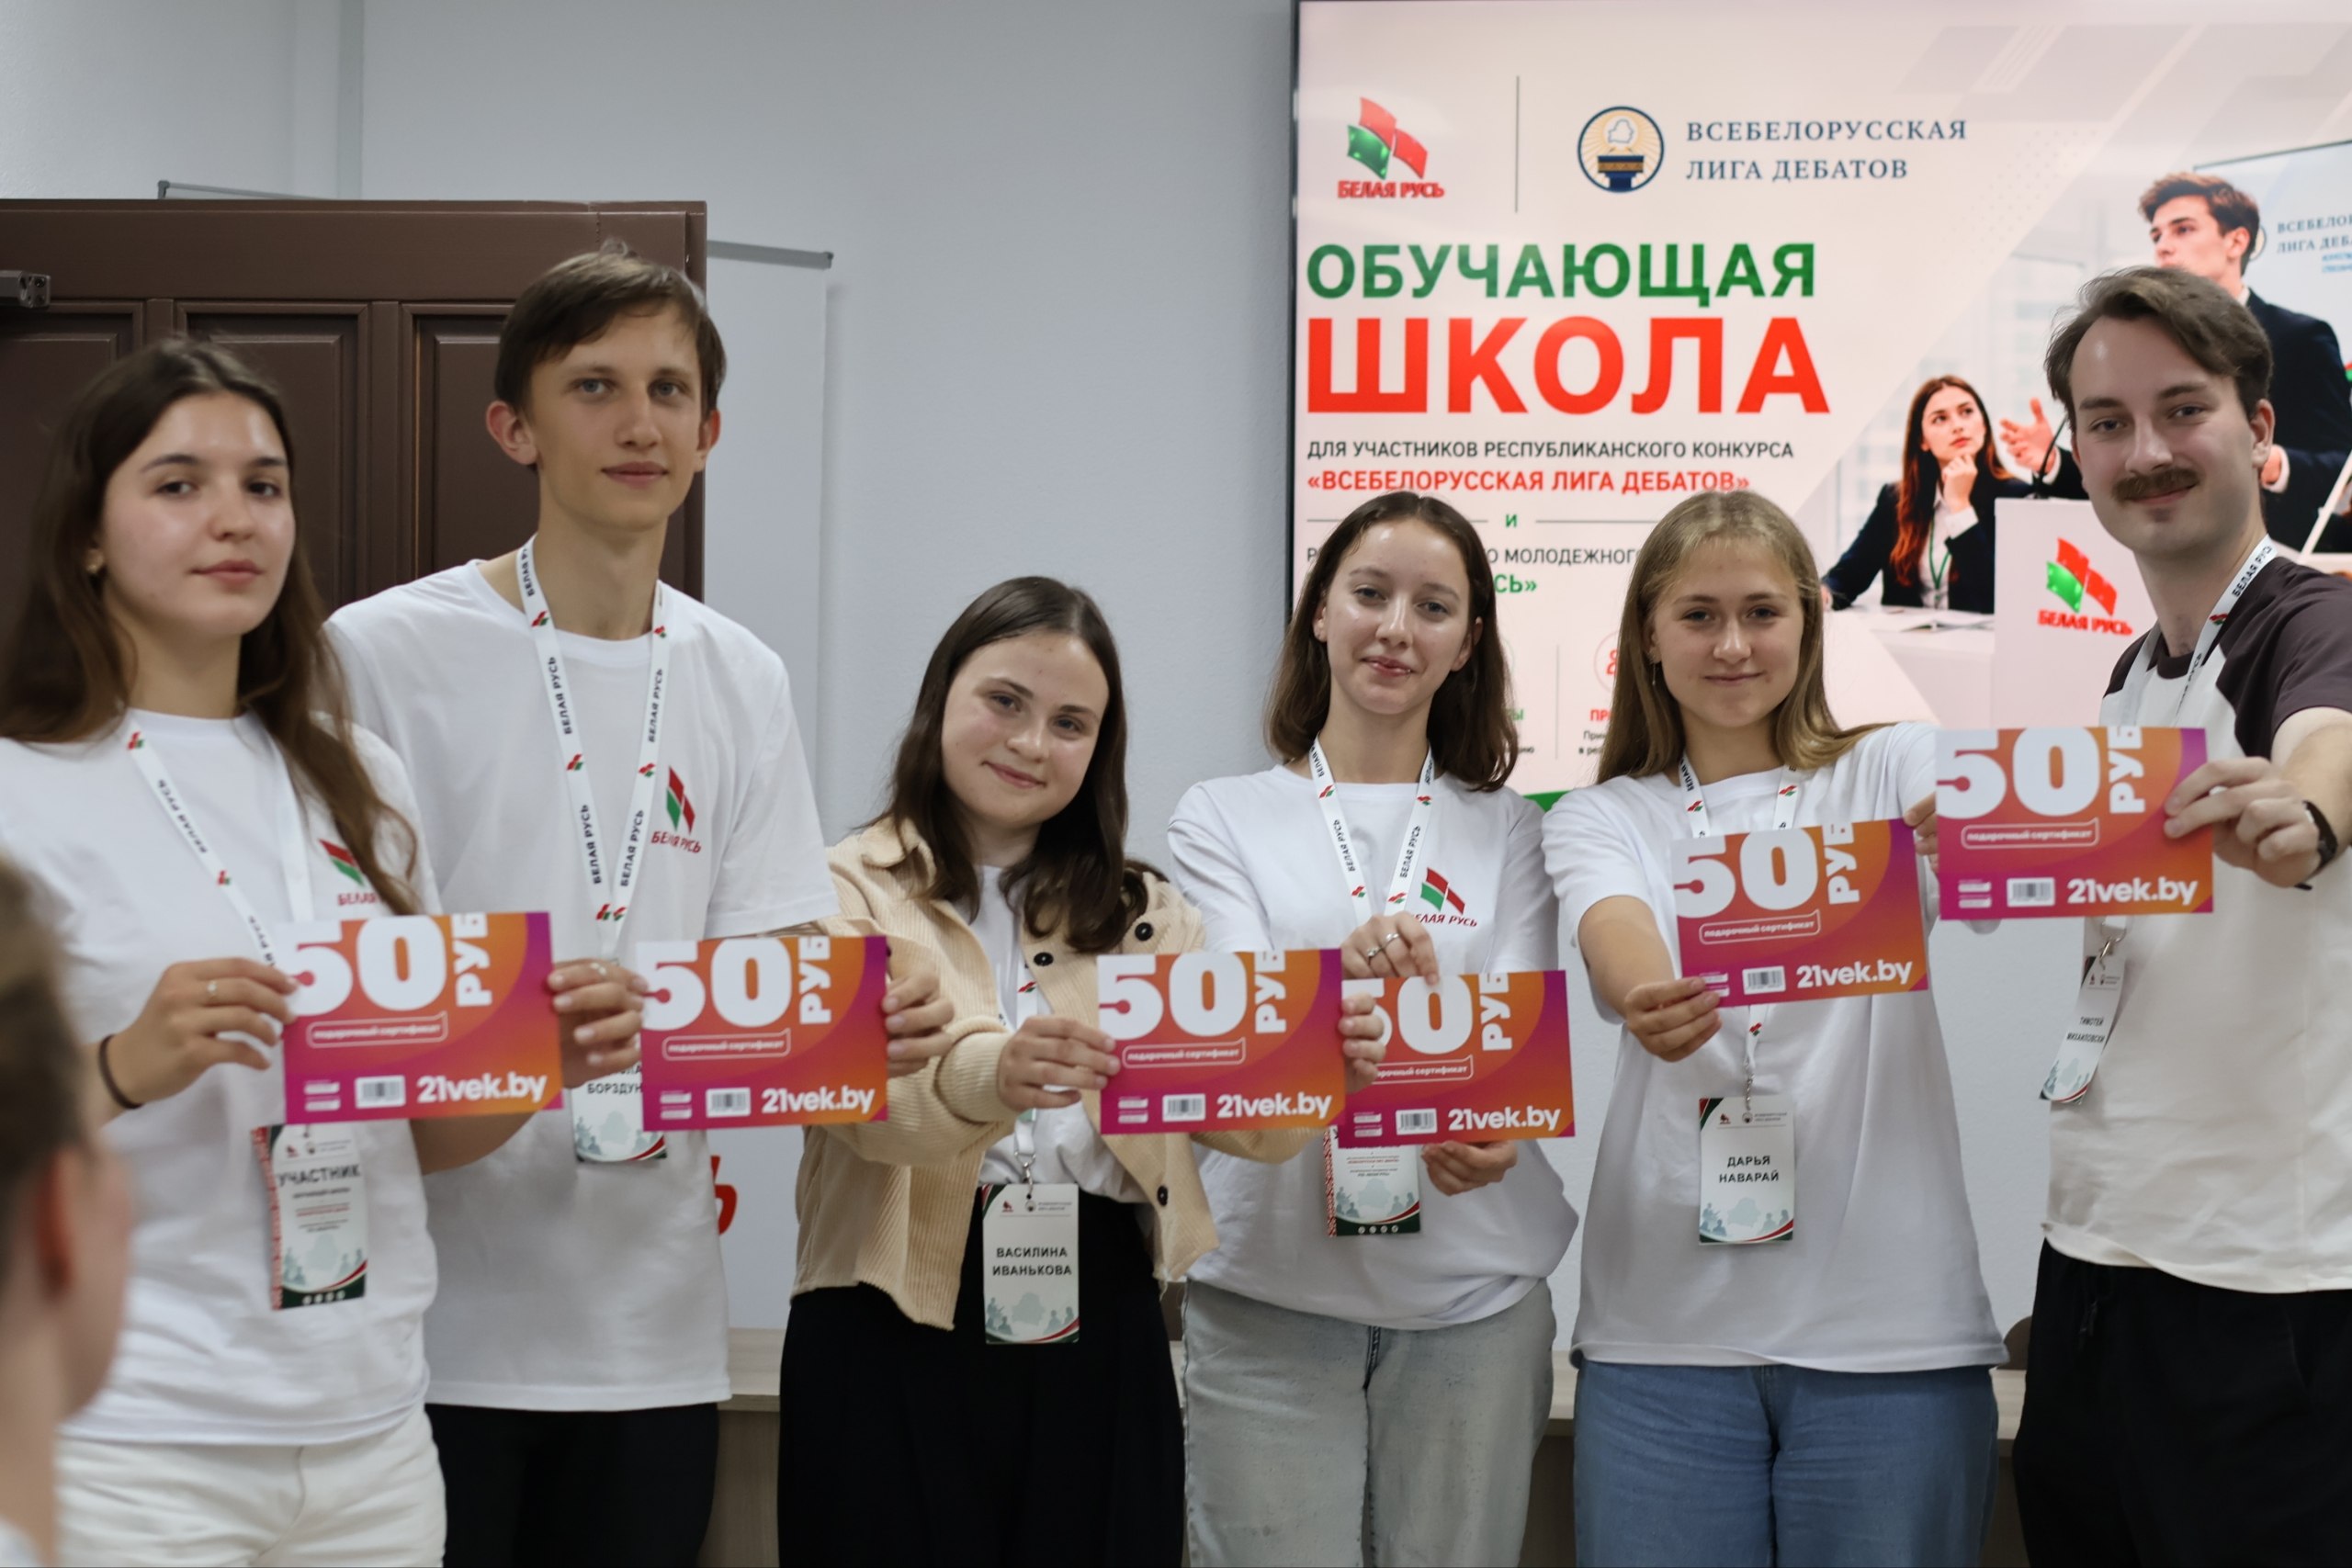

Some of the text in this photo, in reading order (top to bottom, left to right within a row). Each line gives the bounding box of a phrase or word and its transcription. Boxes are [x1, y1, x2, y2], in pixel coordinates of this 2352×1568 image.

[1687, 120, 1967, 141] ВСЕБЕЛОРУССКАЯ
[1686, 159, 1908, 182] ЛИГА ДЕБАТОВ
[1338, 181, 1445, 198] БЕЛАЯ РУСЬ
[1306, 243, 1815, 308] ОБУЧАЮЩАЯ
[1307, 315, 1831, 414] ШКОЛА
[1307, 441, 1793, 459] ДЛЯ УЧАСТНИКОВ РЕСПУБЛИКАНСКОГО КОНКУРСА
[1307, 470, 1749, 494] «ВСЕБЕЛОРУССКАЯ ЛИГА ДЕБАТОВ»
[1505, 513, 1518, 527] И
[1504, 548, 1638, 566] МОЛОДЕЖНОГ
[2232, 563, 2259, 598] БЕЛАЯ
[2038, 610, 2088, 630] БЕЛАЯ
[548, 657, 572, 735] БЕЛАЯ РУСЬ
[648, 669, 664, 742] БЕЛАЯ РУСЬ
[1936, 727, 2100, 819] 50
[2107, 726, 2146, 814] РУБ
[582, 805, 602, 885] БЕЛАЯ РУСЬ
[620, 810, 644, 886] БЕЛАЯ РУСЬ
[1340, 842, 1357, 873] БЕЛАЯ
[1399, 825, 1421, 878] БЕЛАЯ РУСЬ
[1672, 829, 1818, 919] 50
[1822, 824, 1860, 905] РУБ
[2067, 877, 2198, 905] 21vek.by
[1415, 913, 1478, 927] ЕЛАЯ РУСЬ
[284, 915, 447, 1017] 50
[451, 912, 492, 1007] РУБ
[1796, 959, 1913, 988] 21vek.by
[640, 938, 793, 1031] 50
[798, 936, 831, 1024] РУБ
[1254, 950, 1286, 1033] РУБ
[1098, 953, 1248, 1041] 50
[1478, 974, 1513, 1051] РУБ
[416, 1071, 548, 1102] 21vek.by
[762, 1085, 875, 1115] 21vek.by
[1216, 1092, 1332, 1120] 21vek.by
[1447, 1105, 1561, 1131] 21vek.by
[278, 1165, 361, 1187] УЧАСТНИК
[1719, 1168, 1779, 1183] НАВАРАЙ
[1727, 1155, 1770, 1168] ДАРЬЯ
[997, 1247, 1068, 1258] ВАСИЛИНА
[993, 1265, 1072, 1277] ИВАНЬКОВА
